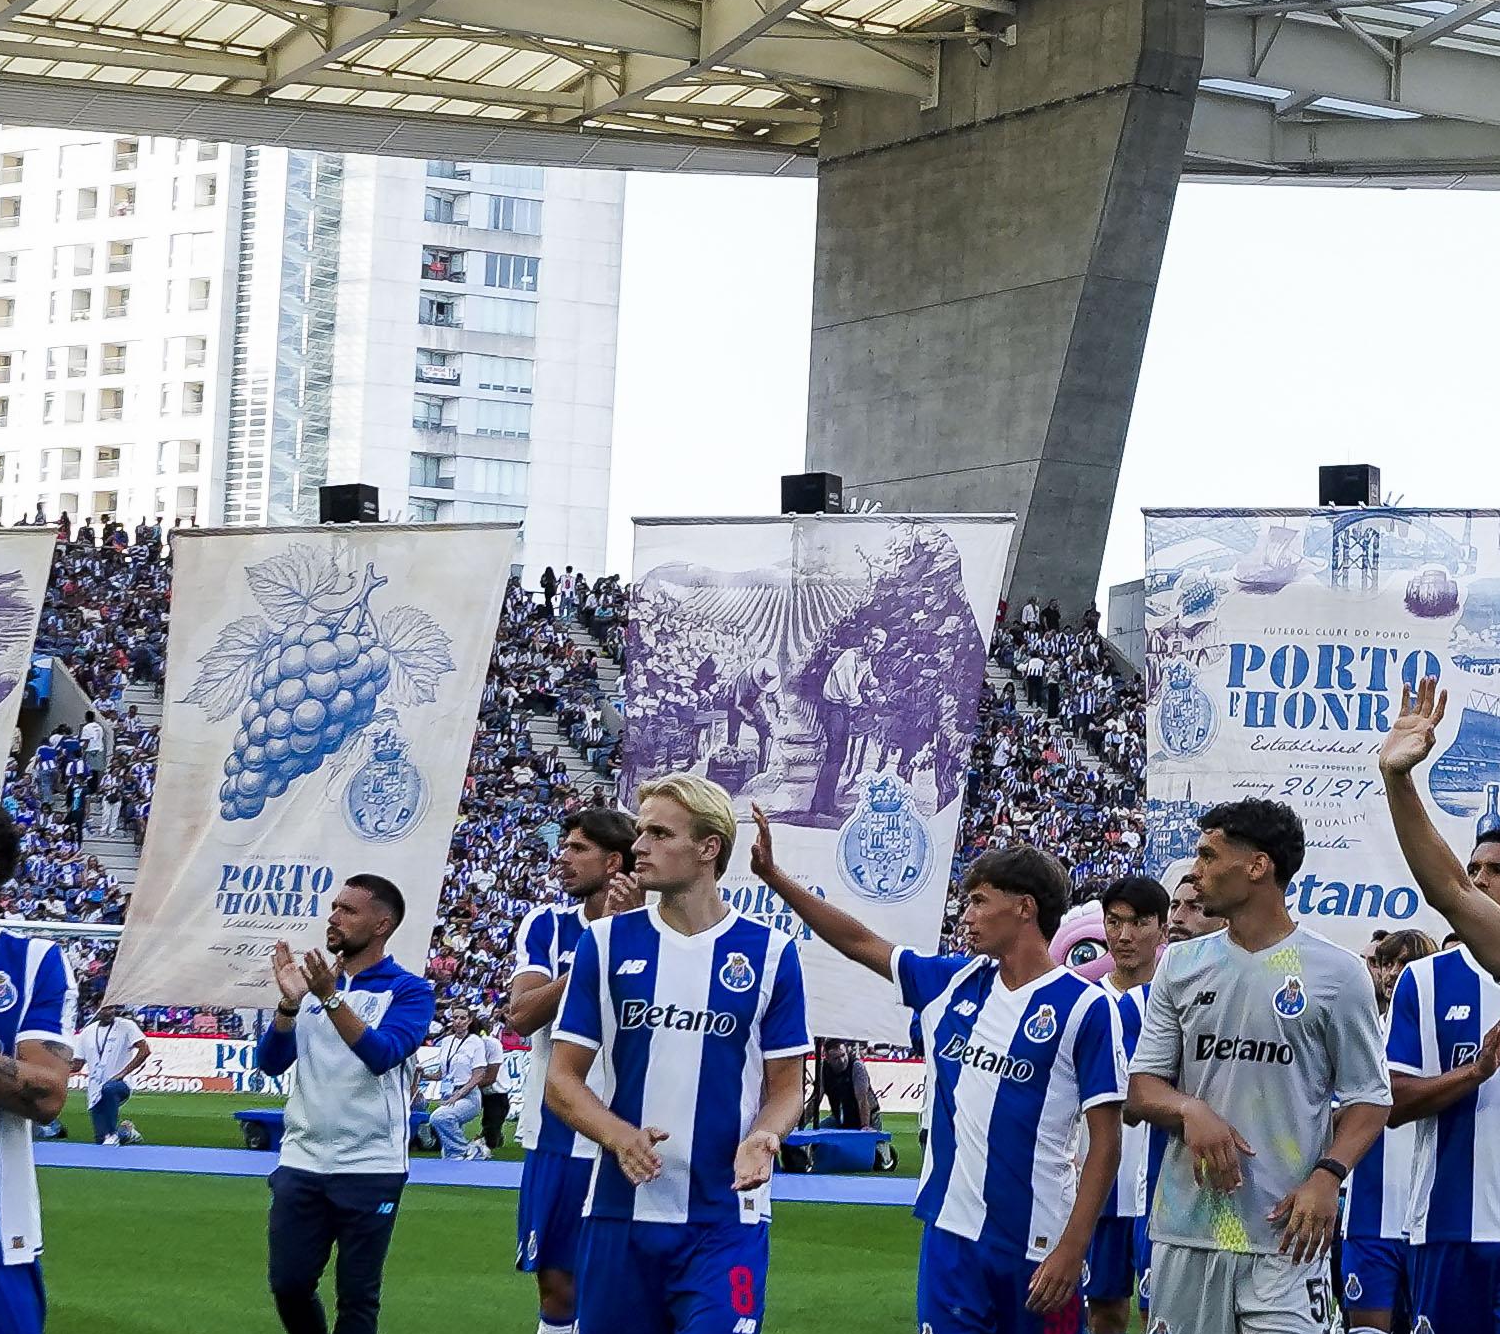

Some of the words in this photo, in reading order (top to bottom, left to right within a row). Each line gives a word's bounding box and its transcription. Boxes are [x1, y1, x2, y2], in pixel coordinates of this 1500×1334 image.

[1263, 627, 1310, 636] FUTEBOL
[1315, 627, 1348, 637] CLUBE
[1354, 629, 1370, 637] DO
[1375, 630, 1411, 640] PORTO
[1226, 643, 1441, 694] PORTO
[1243, 691, 1392, 733] HONR
[1250, 734, 1364, 755] Established
[1279, 777, 1374, 800] 26/27
[1304, 801, 1342, 809] SEASON
[1314, 812, 1367, 828] QUALITY
[216, 864, 335, 894] PORTO
[222, 892, 319, 918] HONRA
[1284, 874, 1419, 919] etano
[620, 998, 738, 1038] Betano
[938, 1033, 1035, 1084] Betano
[1195, 1034, 1295, 1066] Betano
[728, 1266, 755, 1317] 8
